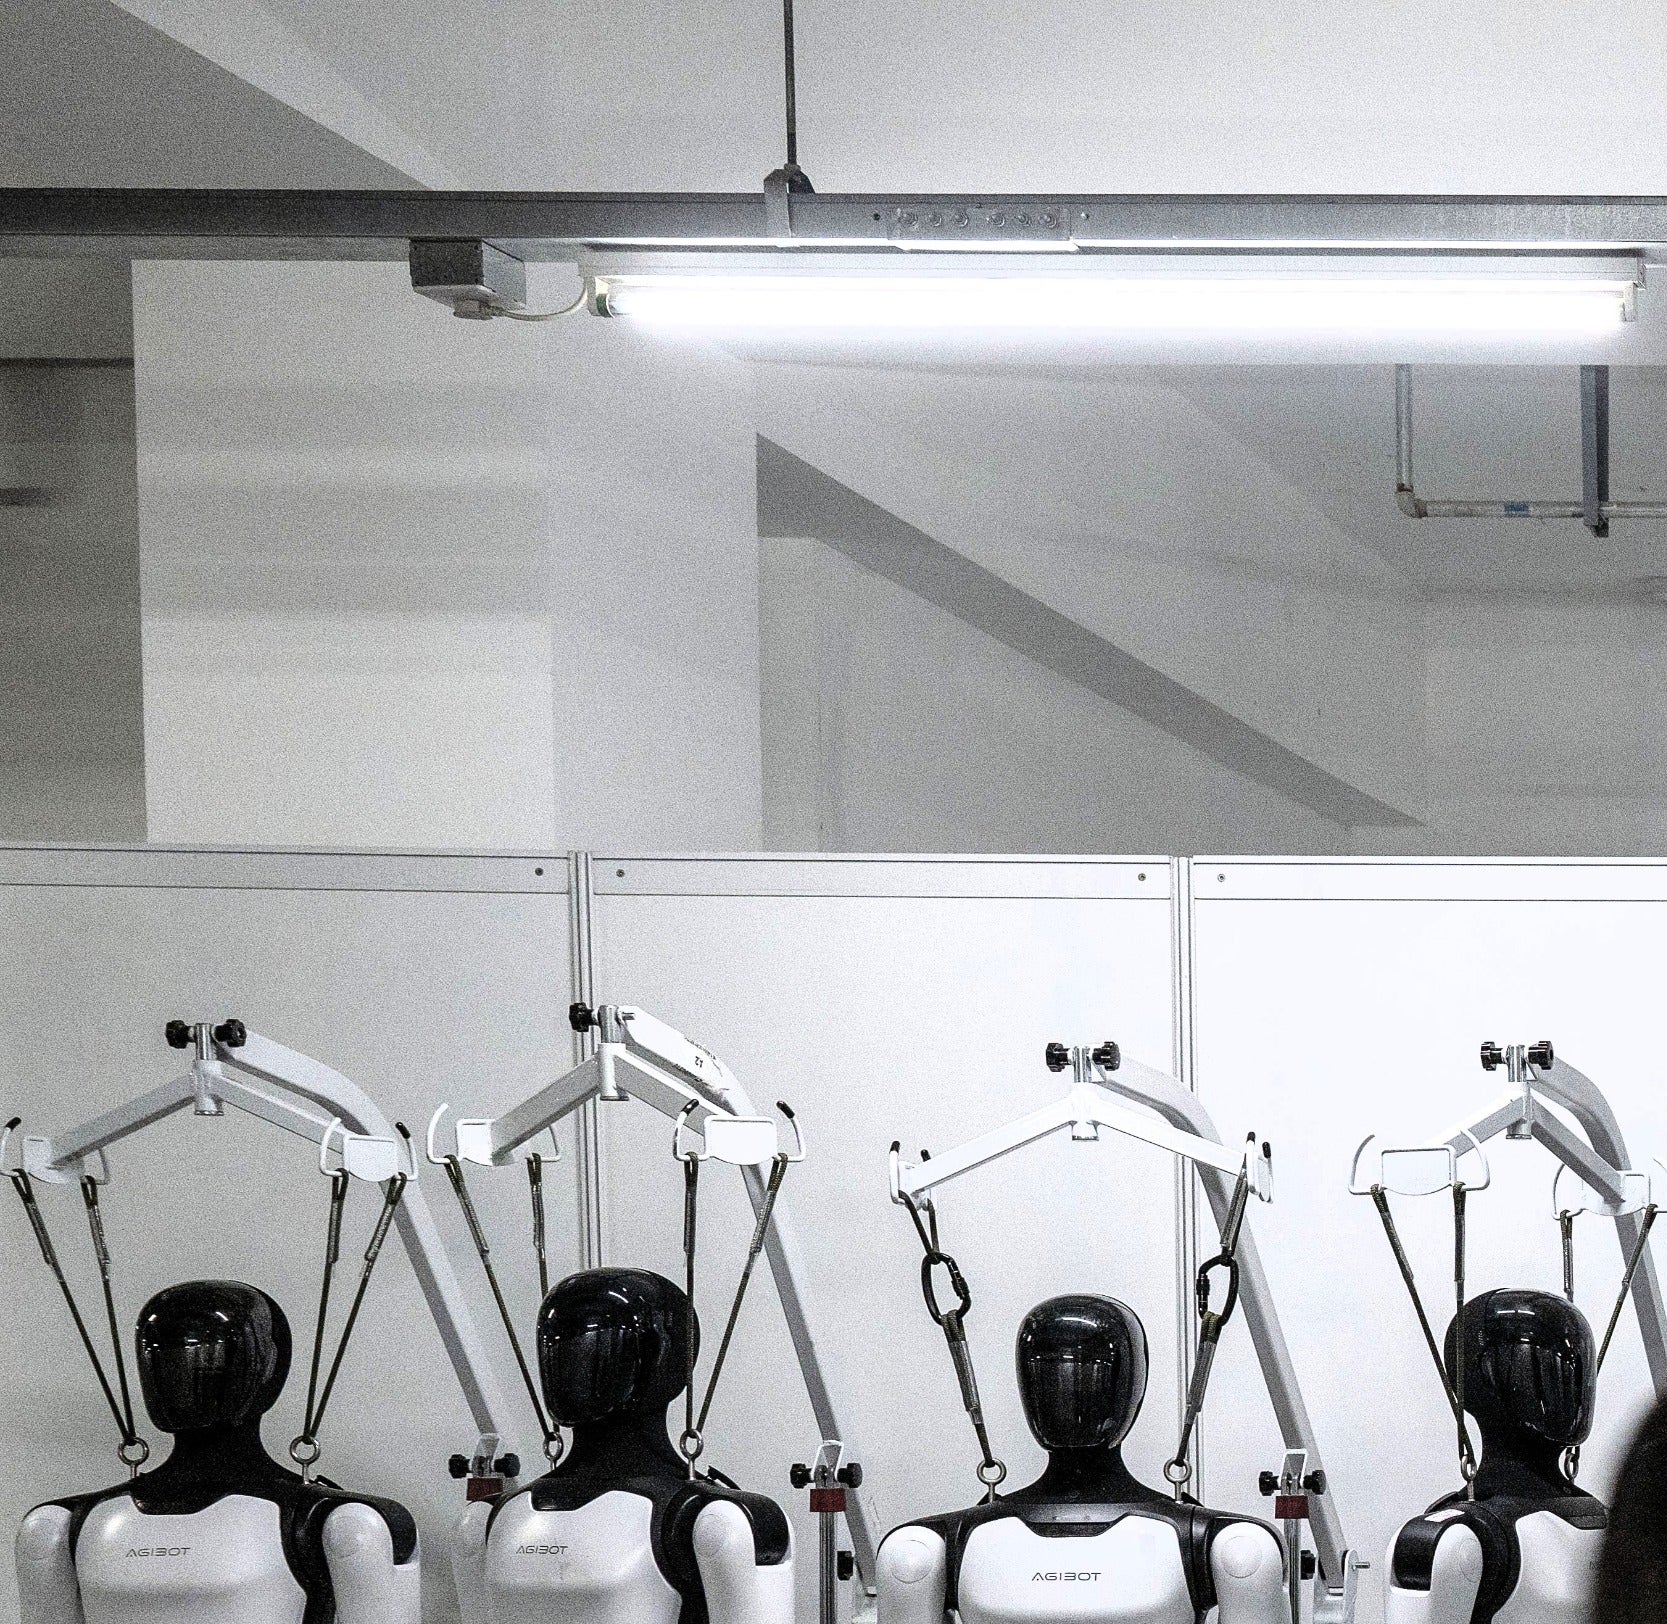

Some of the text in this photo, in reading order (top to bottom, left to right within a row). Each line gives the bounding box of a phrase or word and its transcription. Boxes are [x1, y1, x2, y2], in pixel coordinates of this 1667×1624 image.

[125, 1546, 191, 1558] AGIBOT
[516, 1544, 569, 1556] AGIBOT
[1031, 1571, 1102, 1582] AGIBOT
